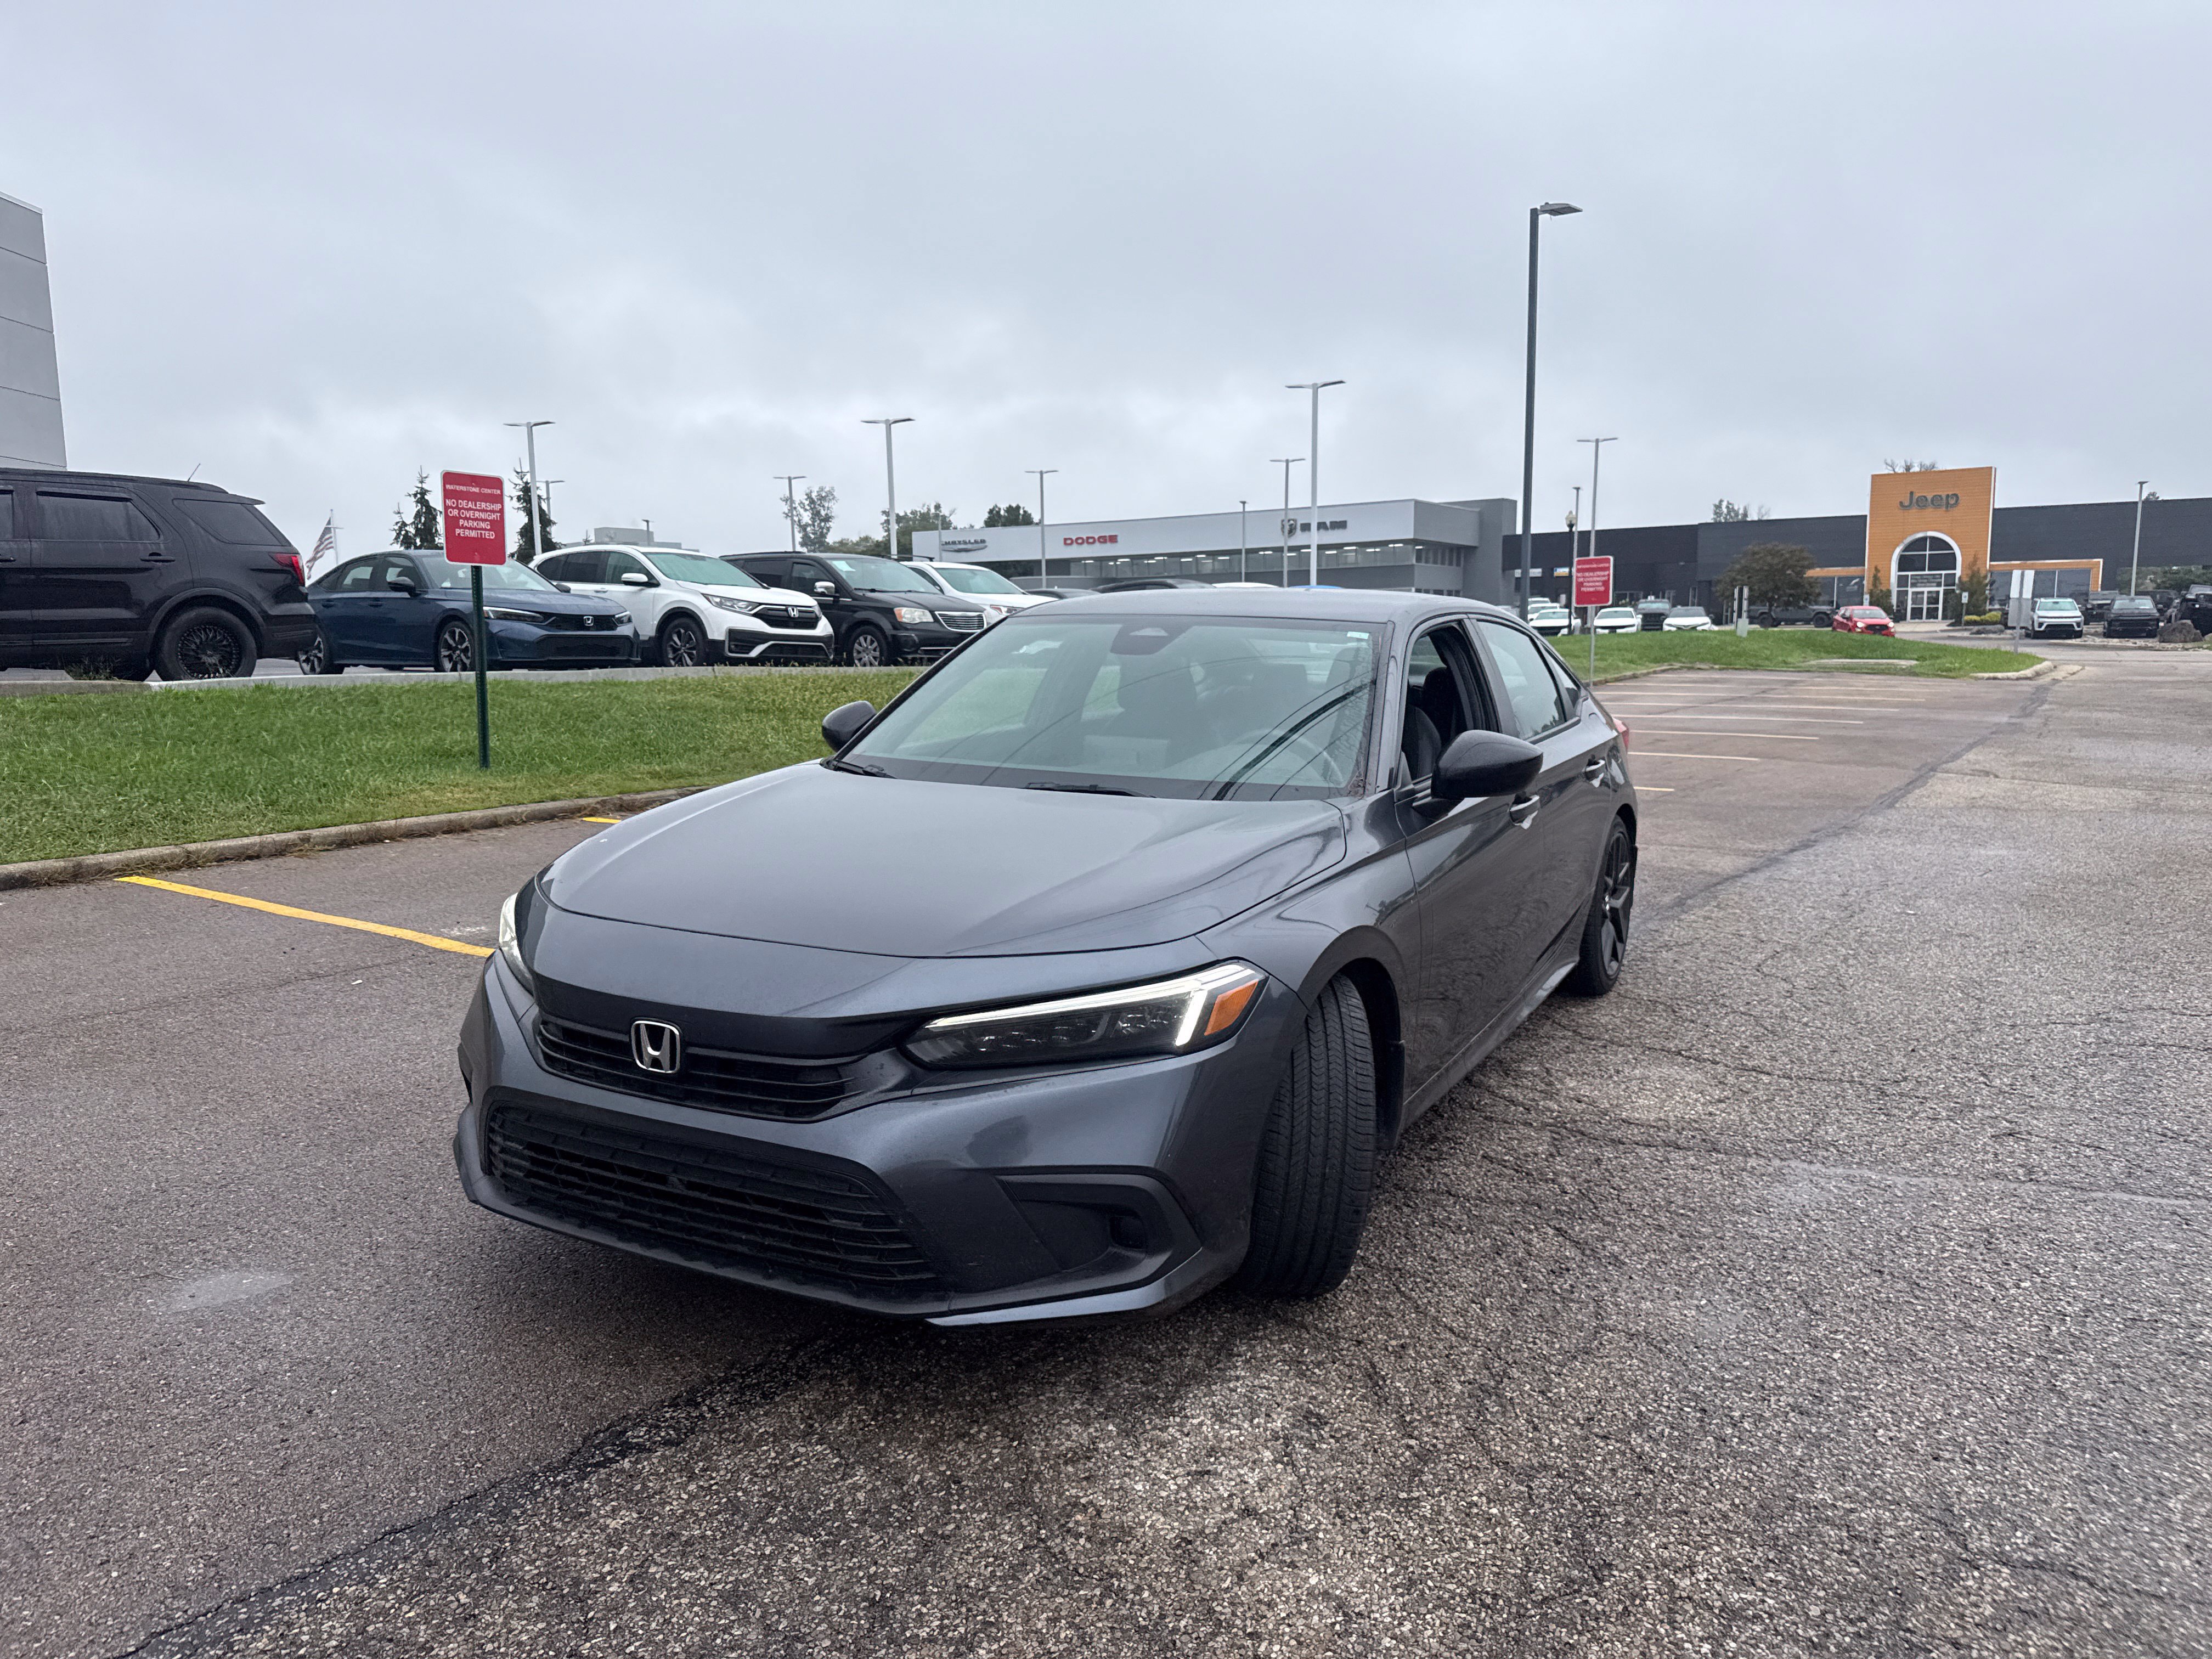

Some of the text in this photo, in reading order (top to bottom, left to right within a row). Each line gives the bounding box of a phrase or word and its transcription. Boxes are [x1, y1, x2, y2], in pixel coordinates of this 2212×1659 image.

[445, 484, 480, 493] WATERSTONE
[445, 498, 502, 511] NO DEALERSHIP
[1899, 491, 1960, 511] Jeep
[448, 509, 501, 521] OR OVERNIGHT
[459, 519, 490, 529] PARKING
[455, 528, 495, 539] PERMITTED
[1063, 534, 1118, 546] DODGE
